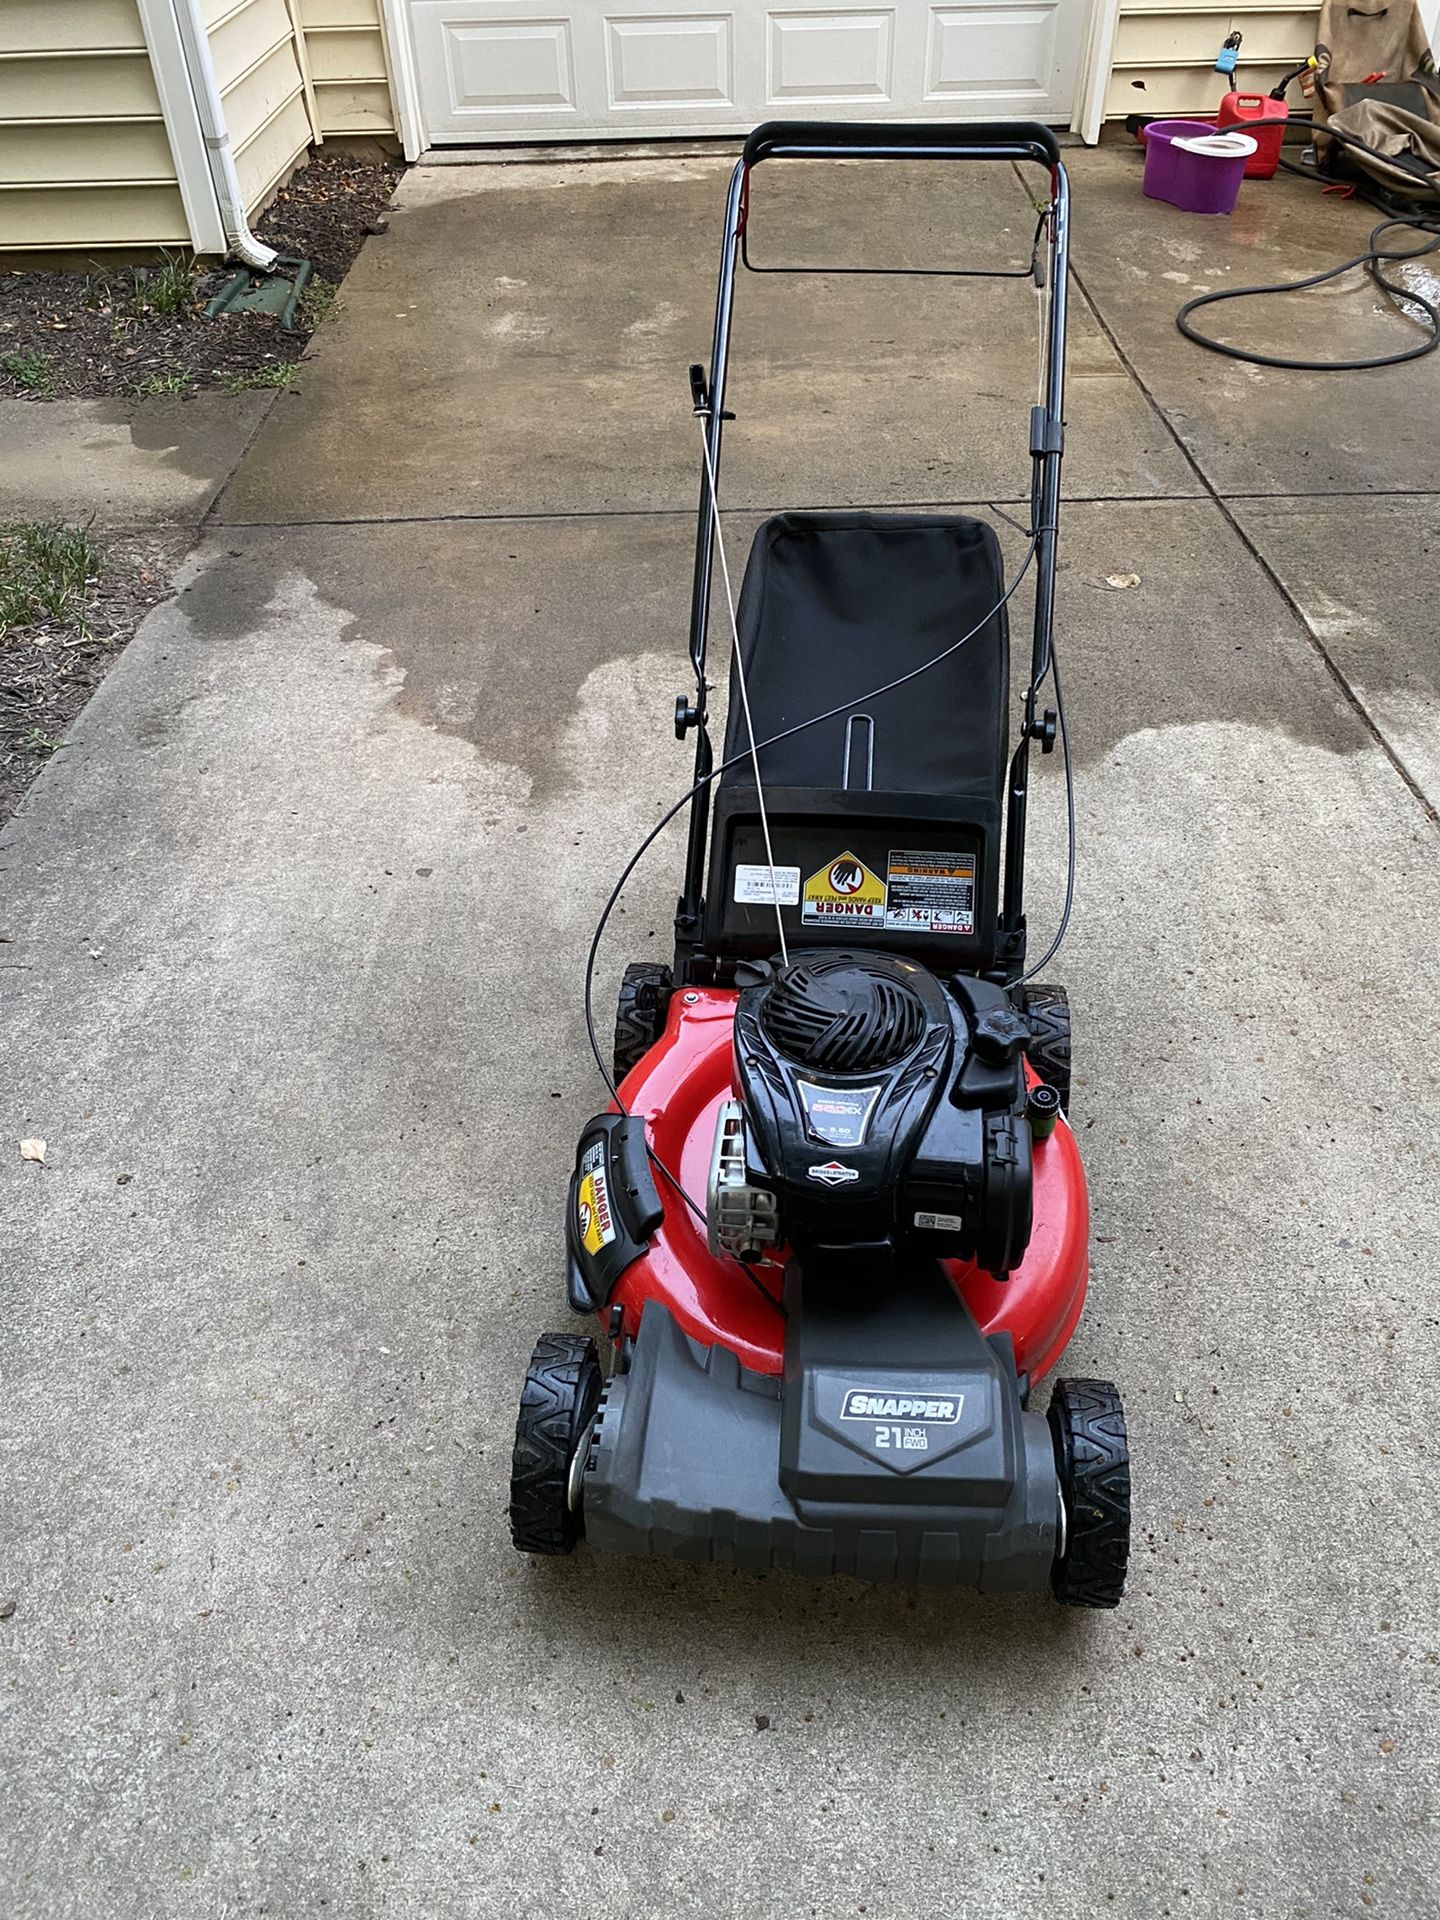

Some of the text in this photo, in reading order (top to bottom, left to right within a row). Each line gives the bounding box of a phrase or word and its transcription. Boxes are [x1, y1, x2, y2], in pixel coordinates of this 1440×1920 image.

[907, 867, 946, 875] WARNING
[815, 902, 873, 915] DANGER
[932, 923, 963, 931] DANGER
[594, 1176, 611, 1232] DANGER
[849, 1395, 954, 1418] SNAPPER
[875, 1426, 926, 1448] 21 INCH
[904, 1438, 926, 1448] FWD
